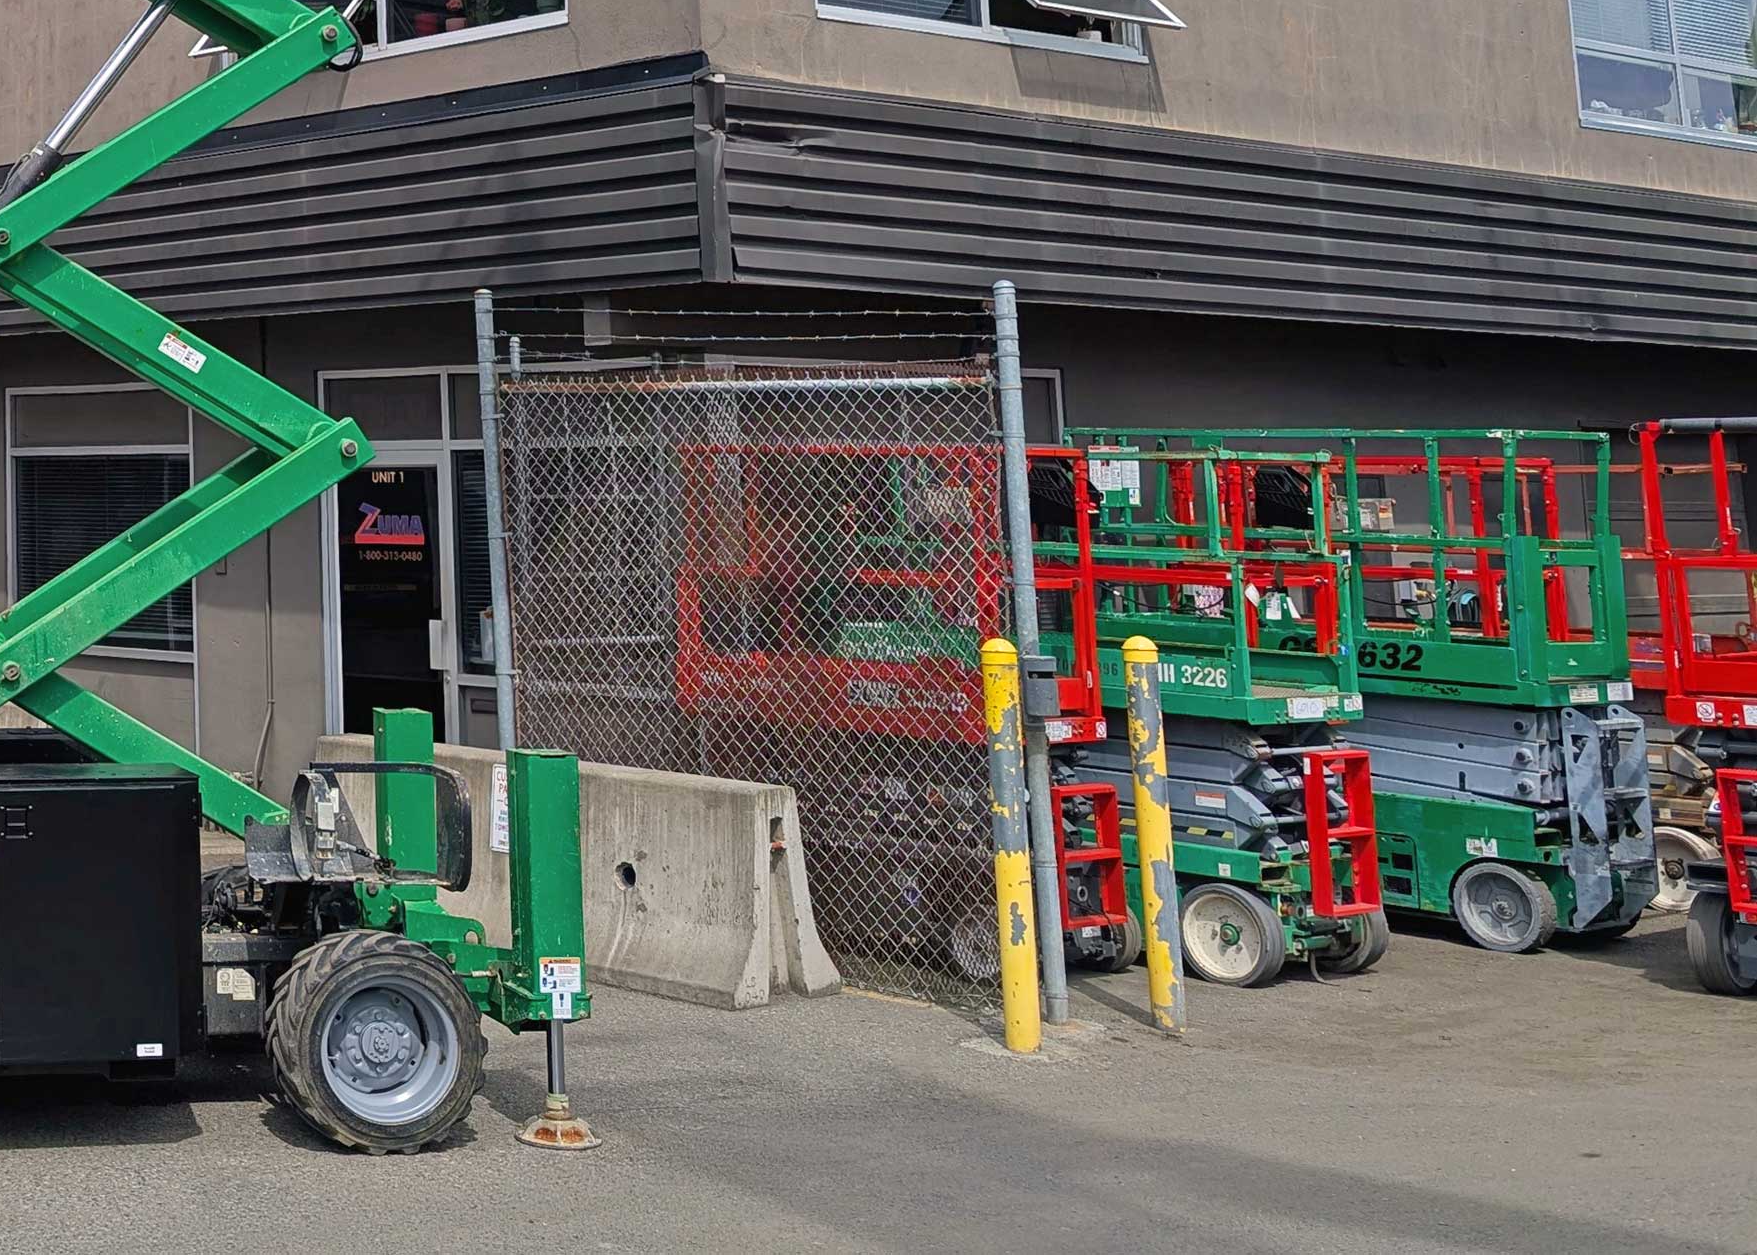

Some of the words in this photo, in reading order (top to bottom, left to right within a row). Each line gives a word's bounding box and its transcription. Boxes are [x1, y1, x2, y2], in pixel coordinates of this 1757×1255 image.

[371, 471, 396, 483] UNIT
[399, 472, 405, 483] 1
[357, 502, 423, 536] ZUMA
[1181, 664, 1228, 689] 3226
